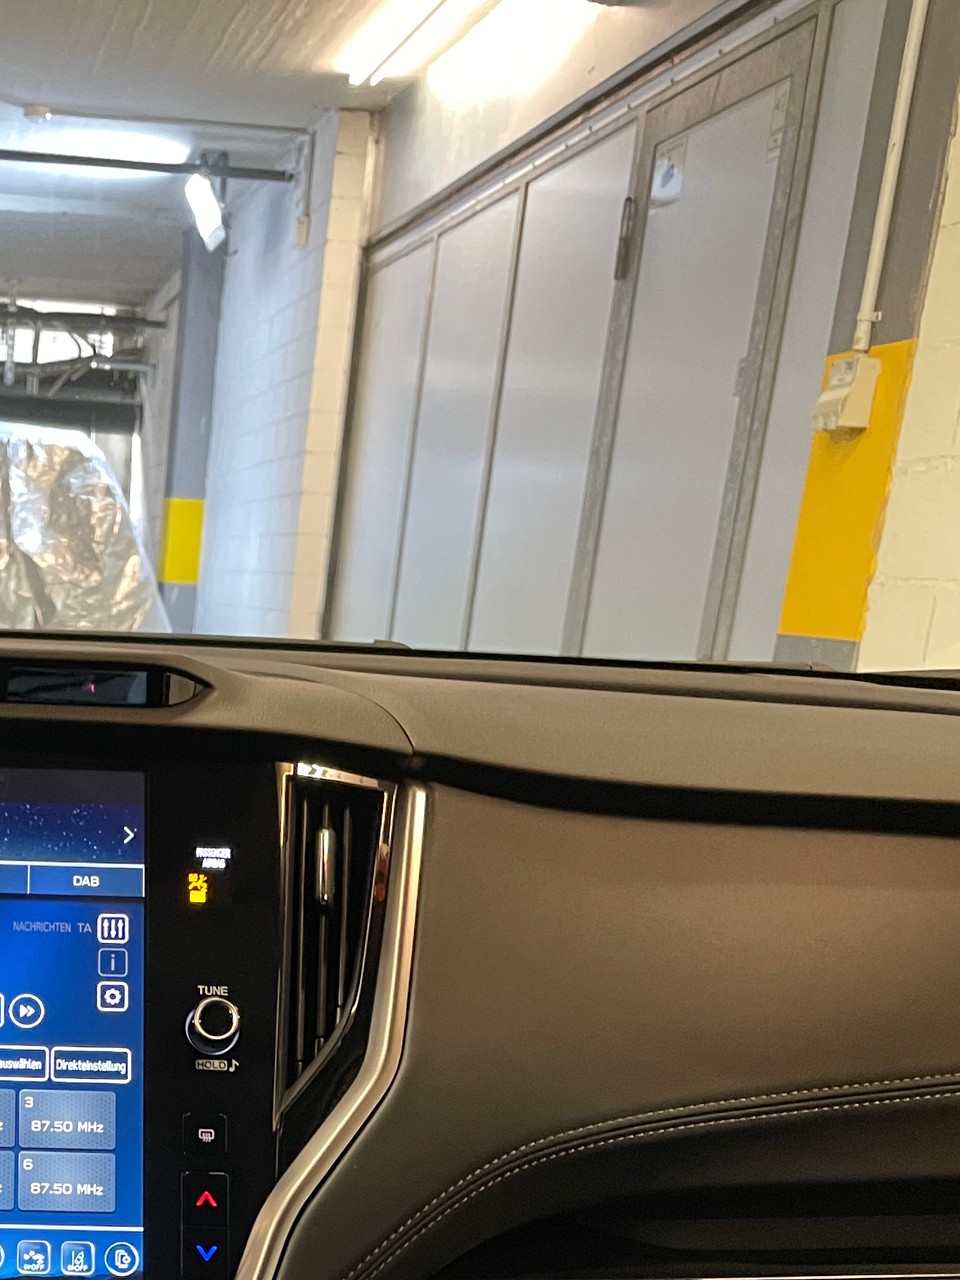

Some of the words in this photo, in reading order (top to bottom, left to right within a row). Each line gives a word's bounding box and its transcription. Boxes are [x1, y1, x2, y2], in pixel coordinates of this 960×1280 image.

[73, 875, 99, 887] DAB
[13, 921, 71, 933] NACHRICHTEN
[77, 923, 92, 933] TA
[197, 985, 228, 996] TUNE
[56, 1059, 126, 1074] Direkteinstellung
[196, 1060, 228, 1070] HOLD
[24, 1097, 34, 1108] 3
[31, 1121, 73, 1133] 87.50
[78, 1122, 104, 1134] MHz
[23, 1159, 33, 1170] 6
[30, 1183, 72, 1195] 87.50
[77, 1184, 103, 1196] MHz
